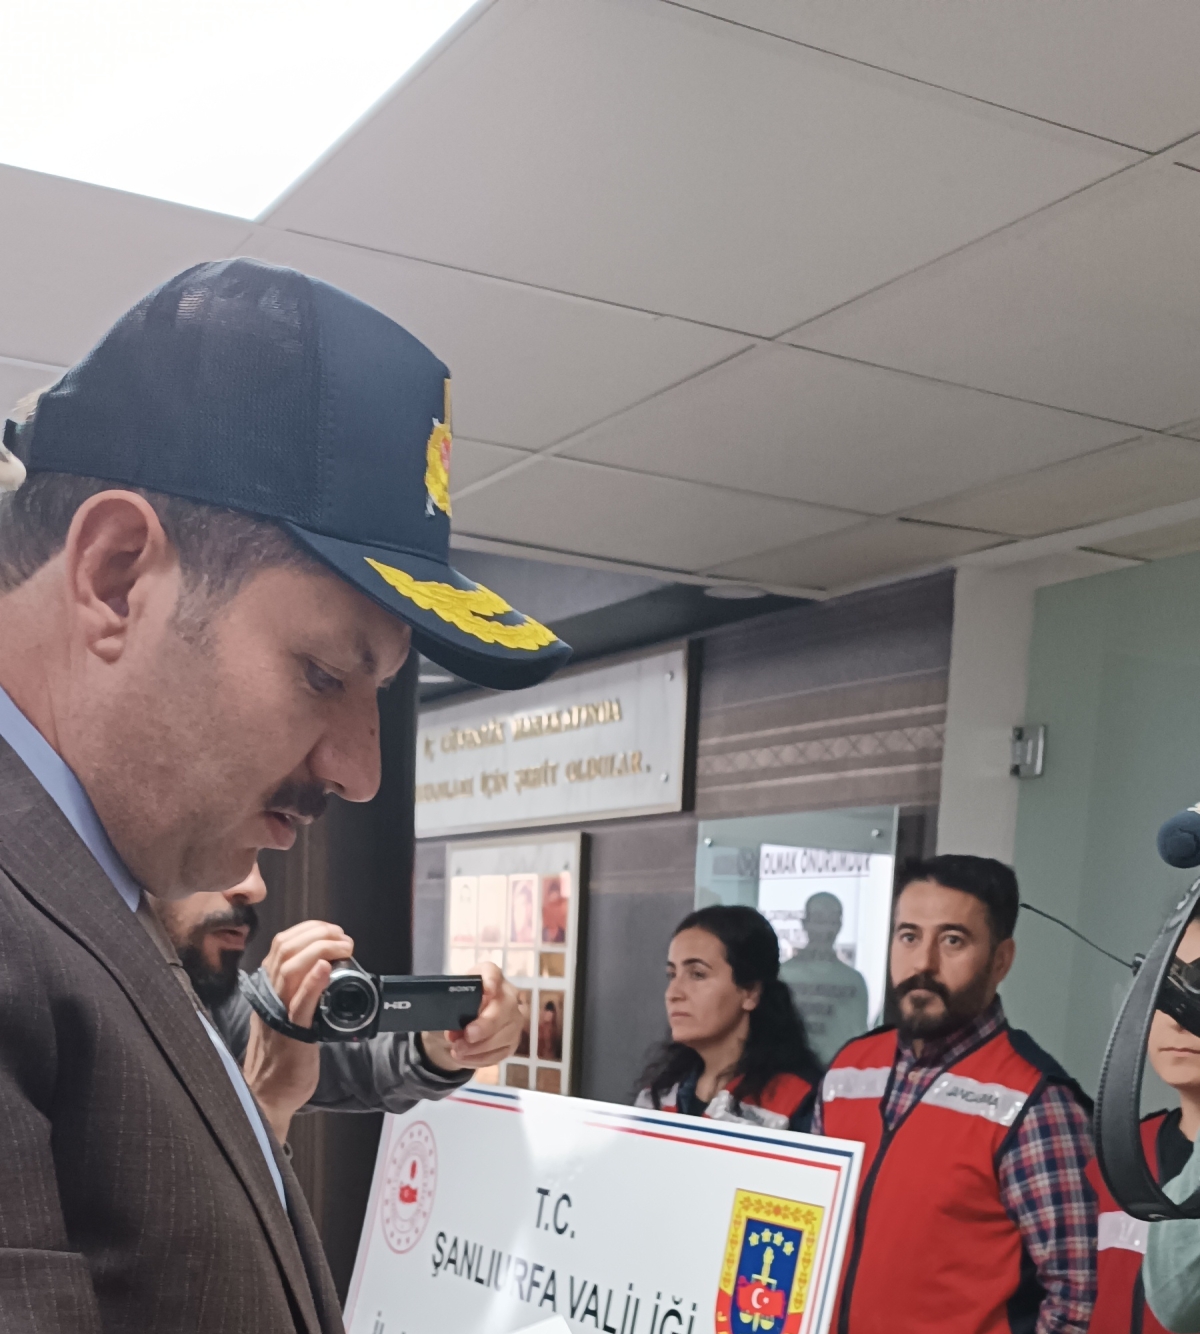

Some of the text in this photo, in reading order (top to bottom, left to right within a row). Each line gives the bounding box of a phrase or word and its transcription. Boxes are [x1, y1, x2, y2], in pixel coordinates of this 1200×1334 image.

[448, 985, 477, 993] SONY
[383, 1000, 412, 1010] HD
[536, 1187, 575, 1239] T.C.
[432, 1231, 557, 1313] ŞANLIURFA
